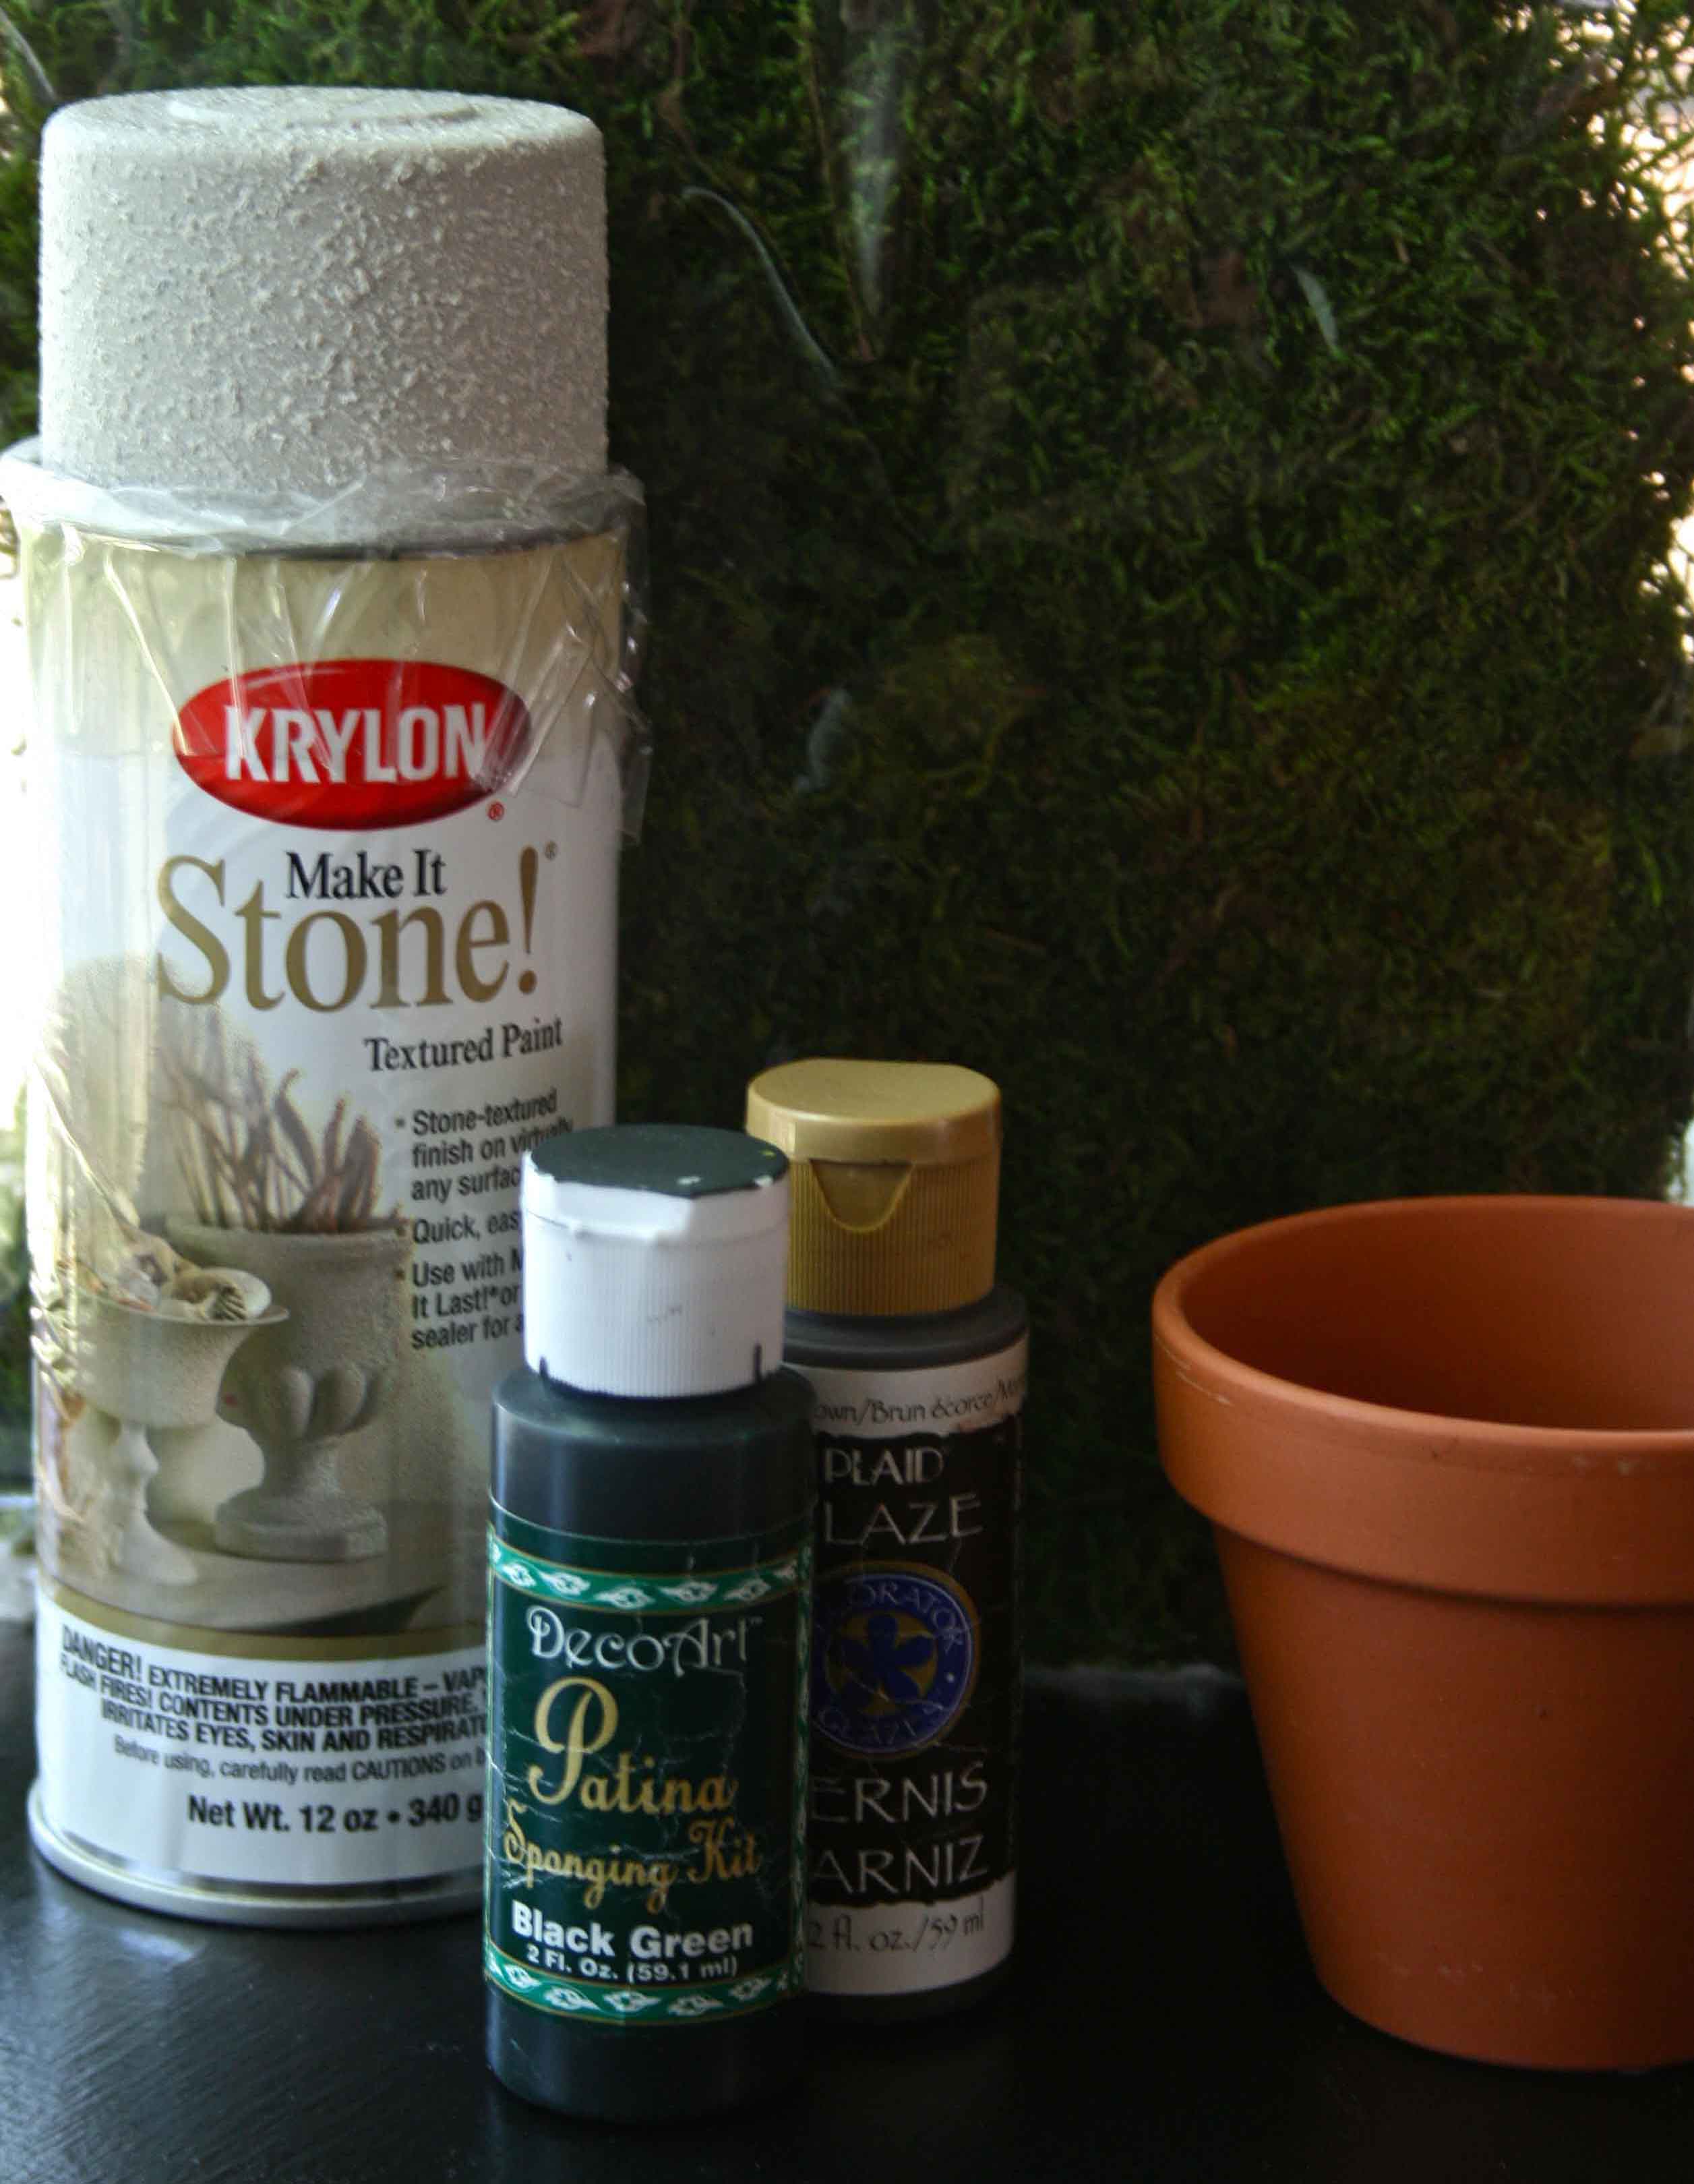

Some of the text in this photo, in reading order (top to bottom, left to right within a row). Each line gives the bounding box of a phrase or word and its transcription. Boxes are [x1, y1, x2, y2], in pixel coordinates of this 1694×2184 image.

[224, 703, 487, 784] KRYLON
[285, 848, 447, 899] Make It
[365, 1017, 564, 1072] Textured Paint
[413, 1086, 557, 1135] Stone-textured
[412, 1141, 473, 1169] finish
[481, 1138, 506, 1160] on
[412, 1167, 520, 1204] any surfac
[413, 1211, 520, 1244] Quick, eas
[413, 1261, 455, 1287] Use
[462, 1251, 505, 1280] with
[412, 1293, 428, 1320] It
[412, 1323, 477, 1351] sealer
[483, 1316, 516, 1340] for
[824, 1446, 944, 1487] PLAID
[824, 1492, 984, 1546] LAZE
[63, 1624, 142, 1682] DANGER!
[148, 1665, 269, 1702] EXTREMELY
[276, 1677, 419, 1703] FLAMMABLE
[443, 1666, 486, 1693] VAP
[60, 1653, 98, 1690] FLASH
[100, 1675, 152, 1709] FIRES!
[160, 1691, 268, 1727] CONTENTS
[276, 1705, 353, 1728] UNDER
[102, 1698, 486, 1752] IRRITATES EYES, SKIN AND RESPIRAT
[528, 1675, 739, 1815] Patina
[219, 1759, 299, 1785] carefully
[305, 1762, 346, 1783] read
[352, 1752, 446, 1781] CAUTIONS
[450, 1753, 472, 1771] on
[811, 1759, 989, 1824] ERNIS
[189, 1795, 235, 1827] Net
[244, 1804, 289, 1834] Wt.
[299, 1804, 335, 1834] 12
[344, 1808, 377, 1833] oz
[409, 1793, 460, 1828] 340
[503, 1798, 760, 1915] Sponging Kit
[812, 1833, 990, 1894] ARNIZ
[512, 1899, 754, 1959] Black Green
[964, 1894, 984, 1935] ml
[525, 1942, 739, 1984] 2 Fl. Oz. (59.1 ml)
